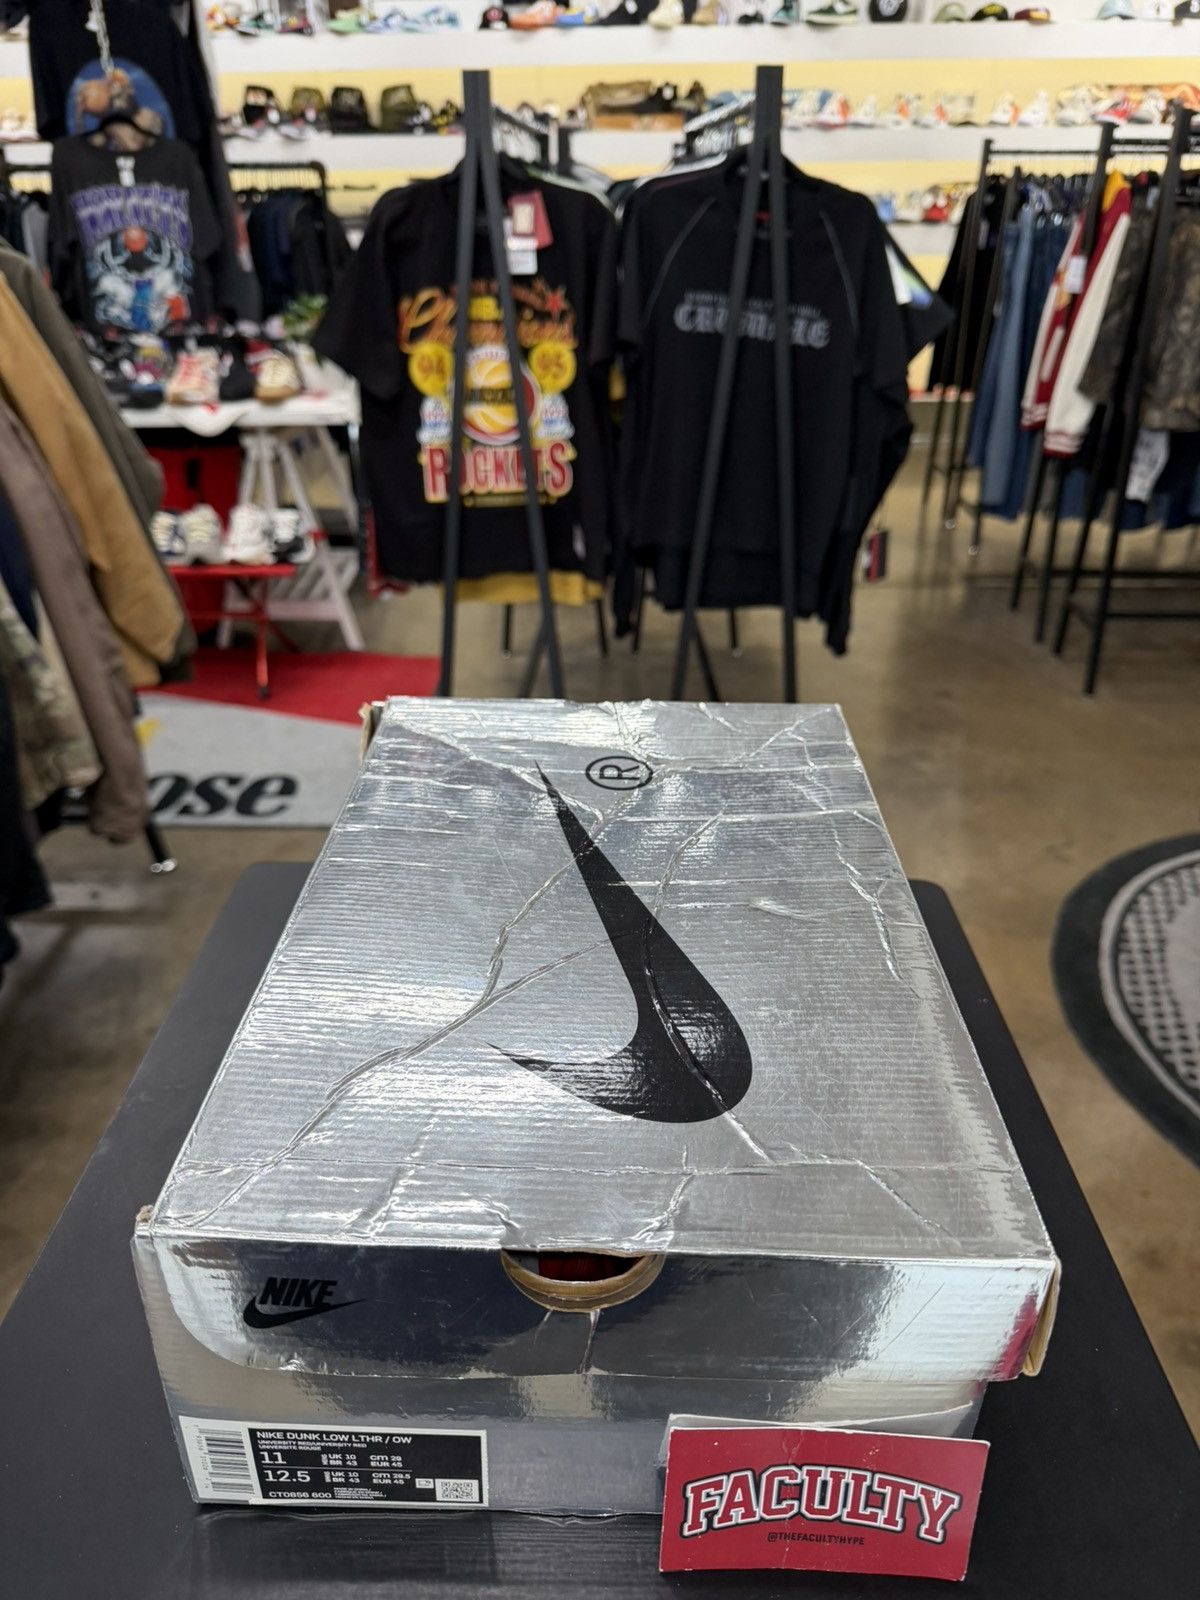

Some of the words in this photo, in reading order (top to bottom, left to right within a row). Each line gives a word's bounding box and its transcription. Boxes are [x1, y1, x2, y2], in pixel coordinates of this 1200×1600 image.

[259, 1277, 337, 1307] NIKE
[256, 1431, 284, 1440] NIKE
[286, 1432, 321, 1441] DUNK
[323, 1433, 349, 1442] LOW
[352, 1434, 383, 1443] LTHR
[392, 1435, 412, 1444] OW
[260, 1451, 287, 1464] 11
[263, 1470, 311, 1482] 12.5
[681, 1464, 962, 1544] FACULTY
[767, 1531, 865, 1546] @THEFACULTYHYPE
